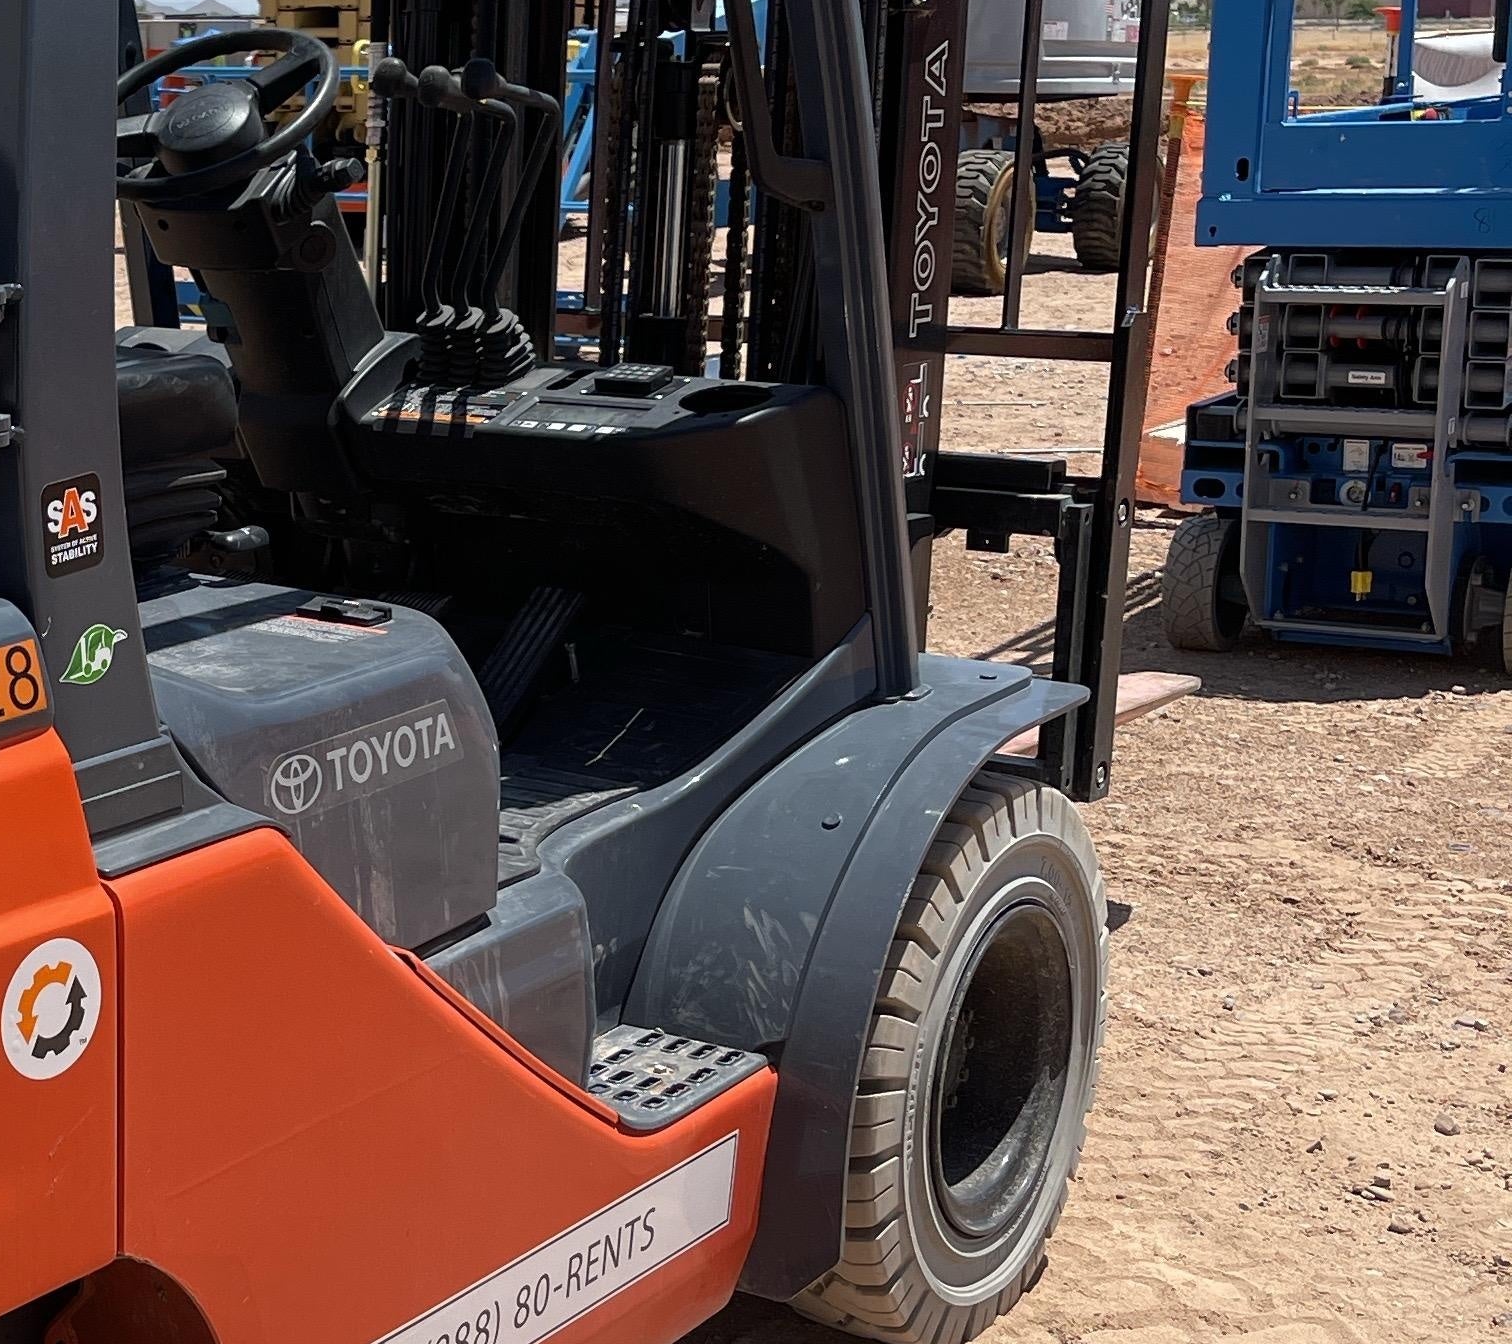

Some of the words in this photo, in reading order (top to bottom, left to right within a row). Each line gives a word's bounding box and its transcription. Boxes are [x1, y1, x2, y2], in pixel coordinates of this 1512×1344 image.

[909, 39, 950, 338] TOYOTA
[47, 487, 98, 539] SAS
[51, 542, 98, 565] STABILITY
[326, 712, 456, 791] TOYOTA
[512, 1207, 657, 1330] 80-RENTS
